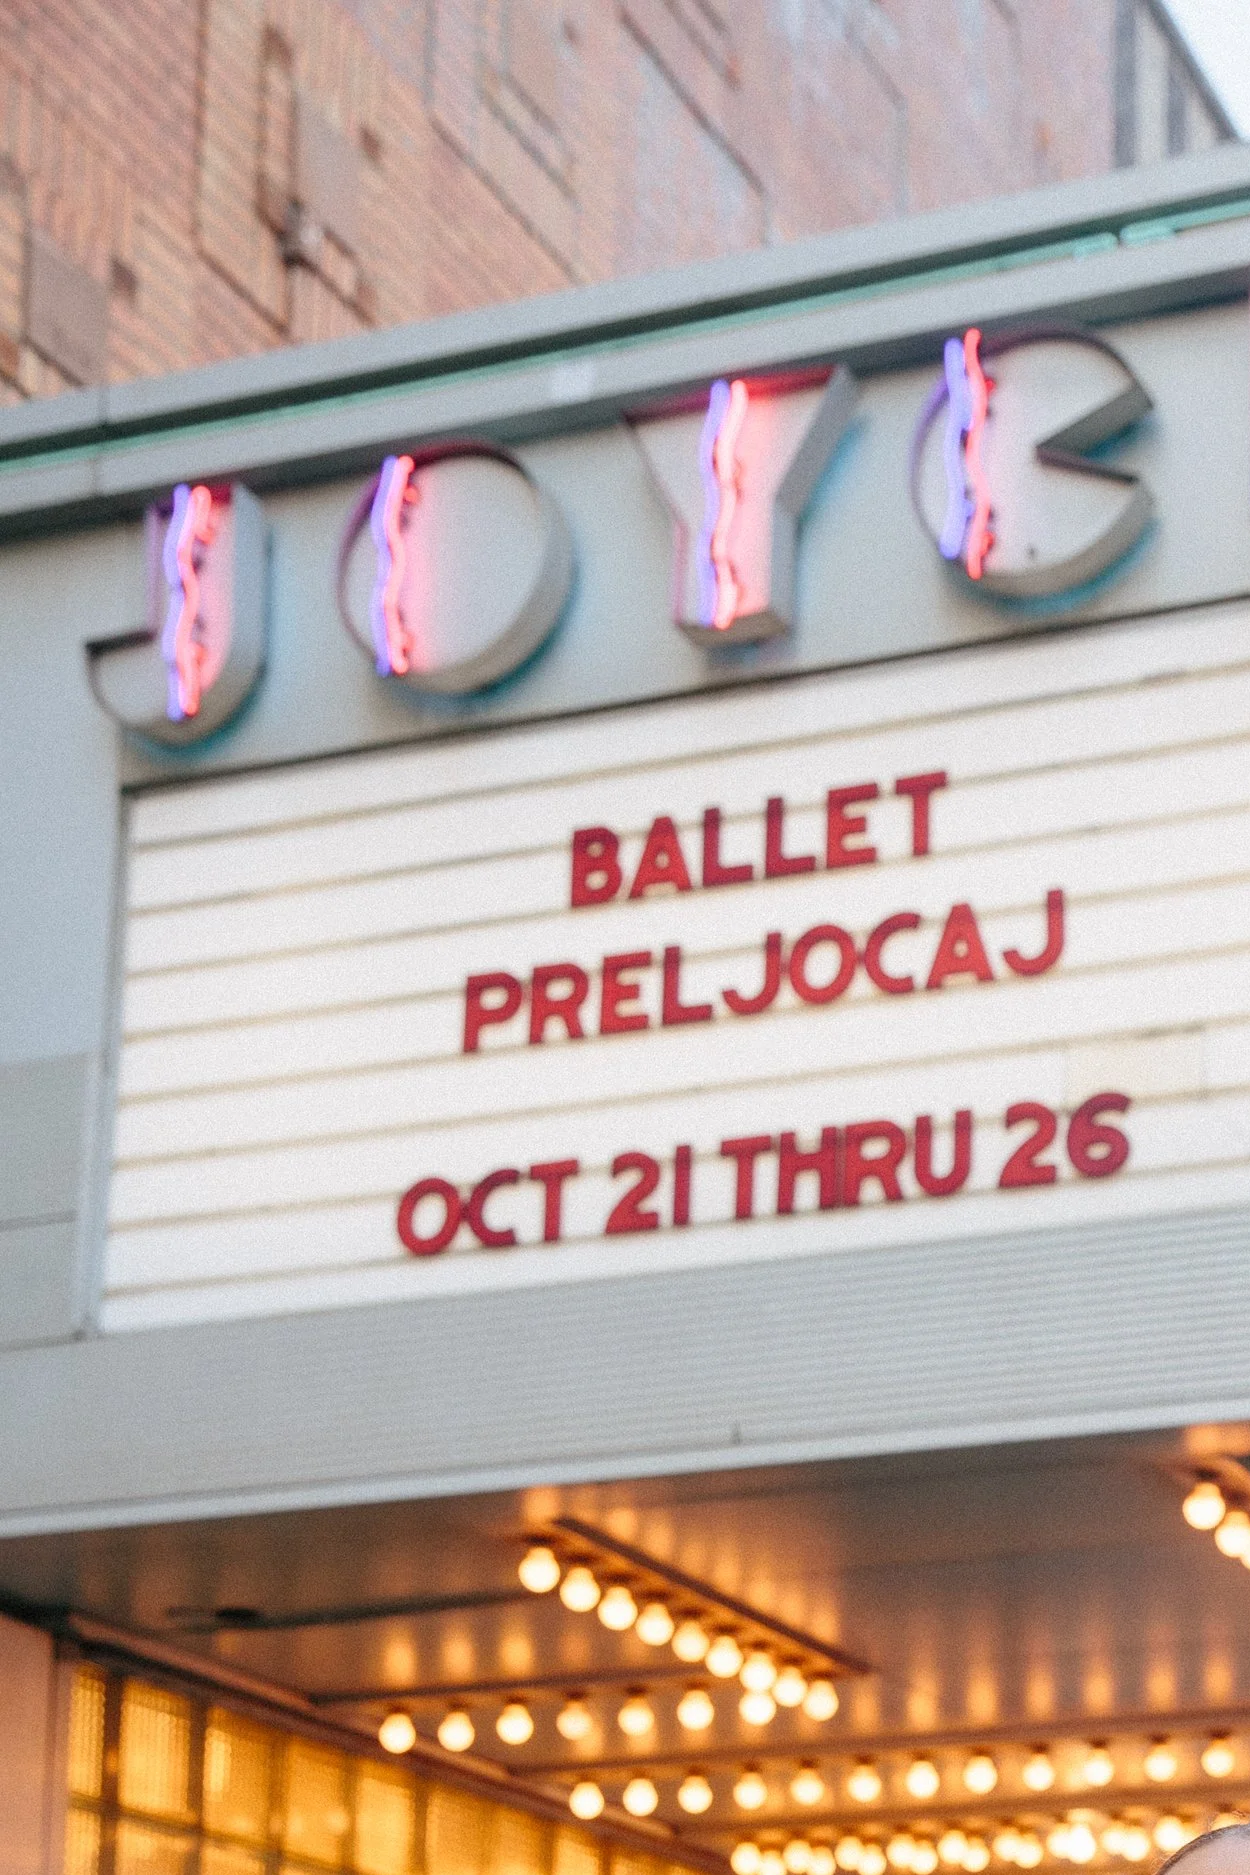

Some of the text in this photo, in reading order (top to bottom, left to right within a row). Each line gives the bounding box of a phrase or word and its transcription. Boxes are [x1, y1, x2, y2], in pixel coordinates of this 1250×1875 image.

[569, 770, 948, 909] BALLET
[462, 887, 1066, 1054] PRELJOCAJ
[395, 1091, 1131, 1257] OCT 21 THRU 26
